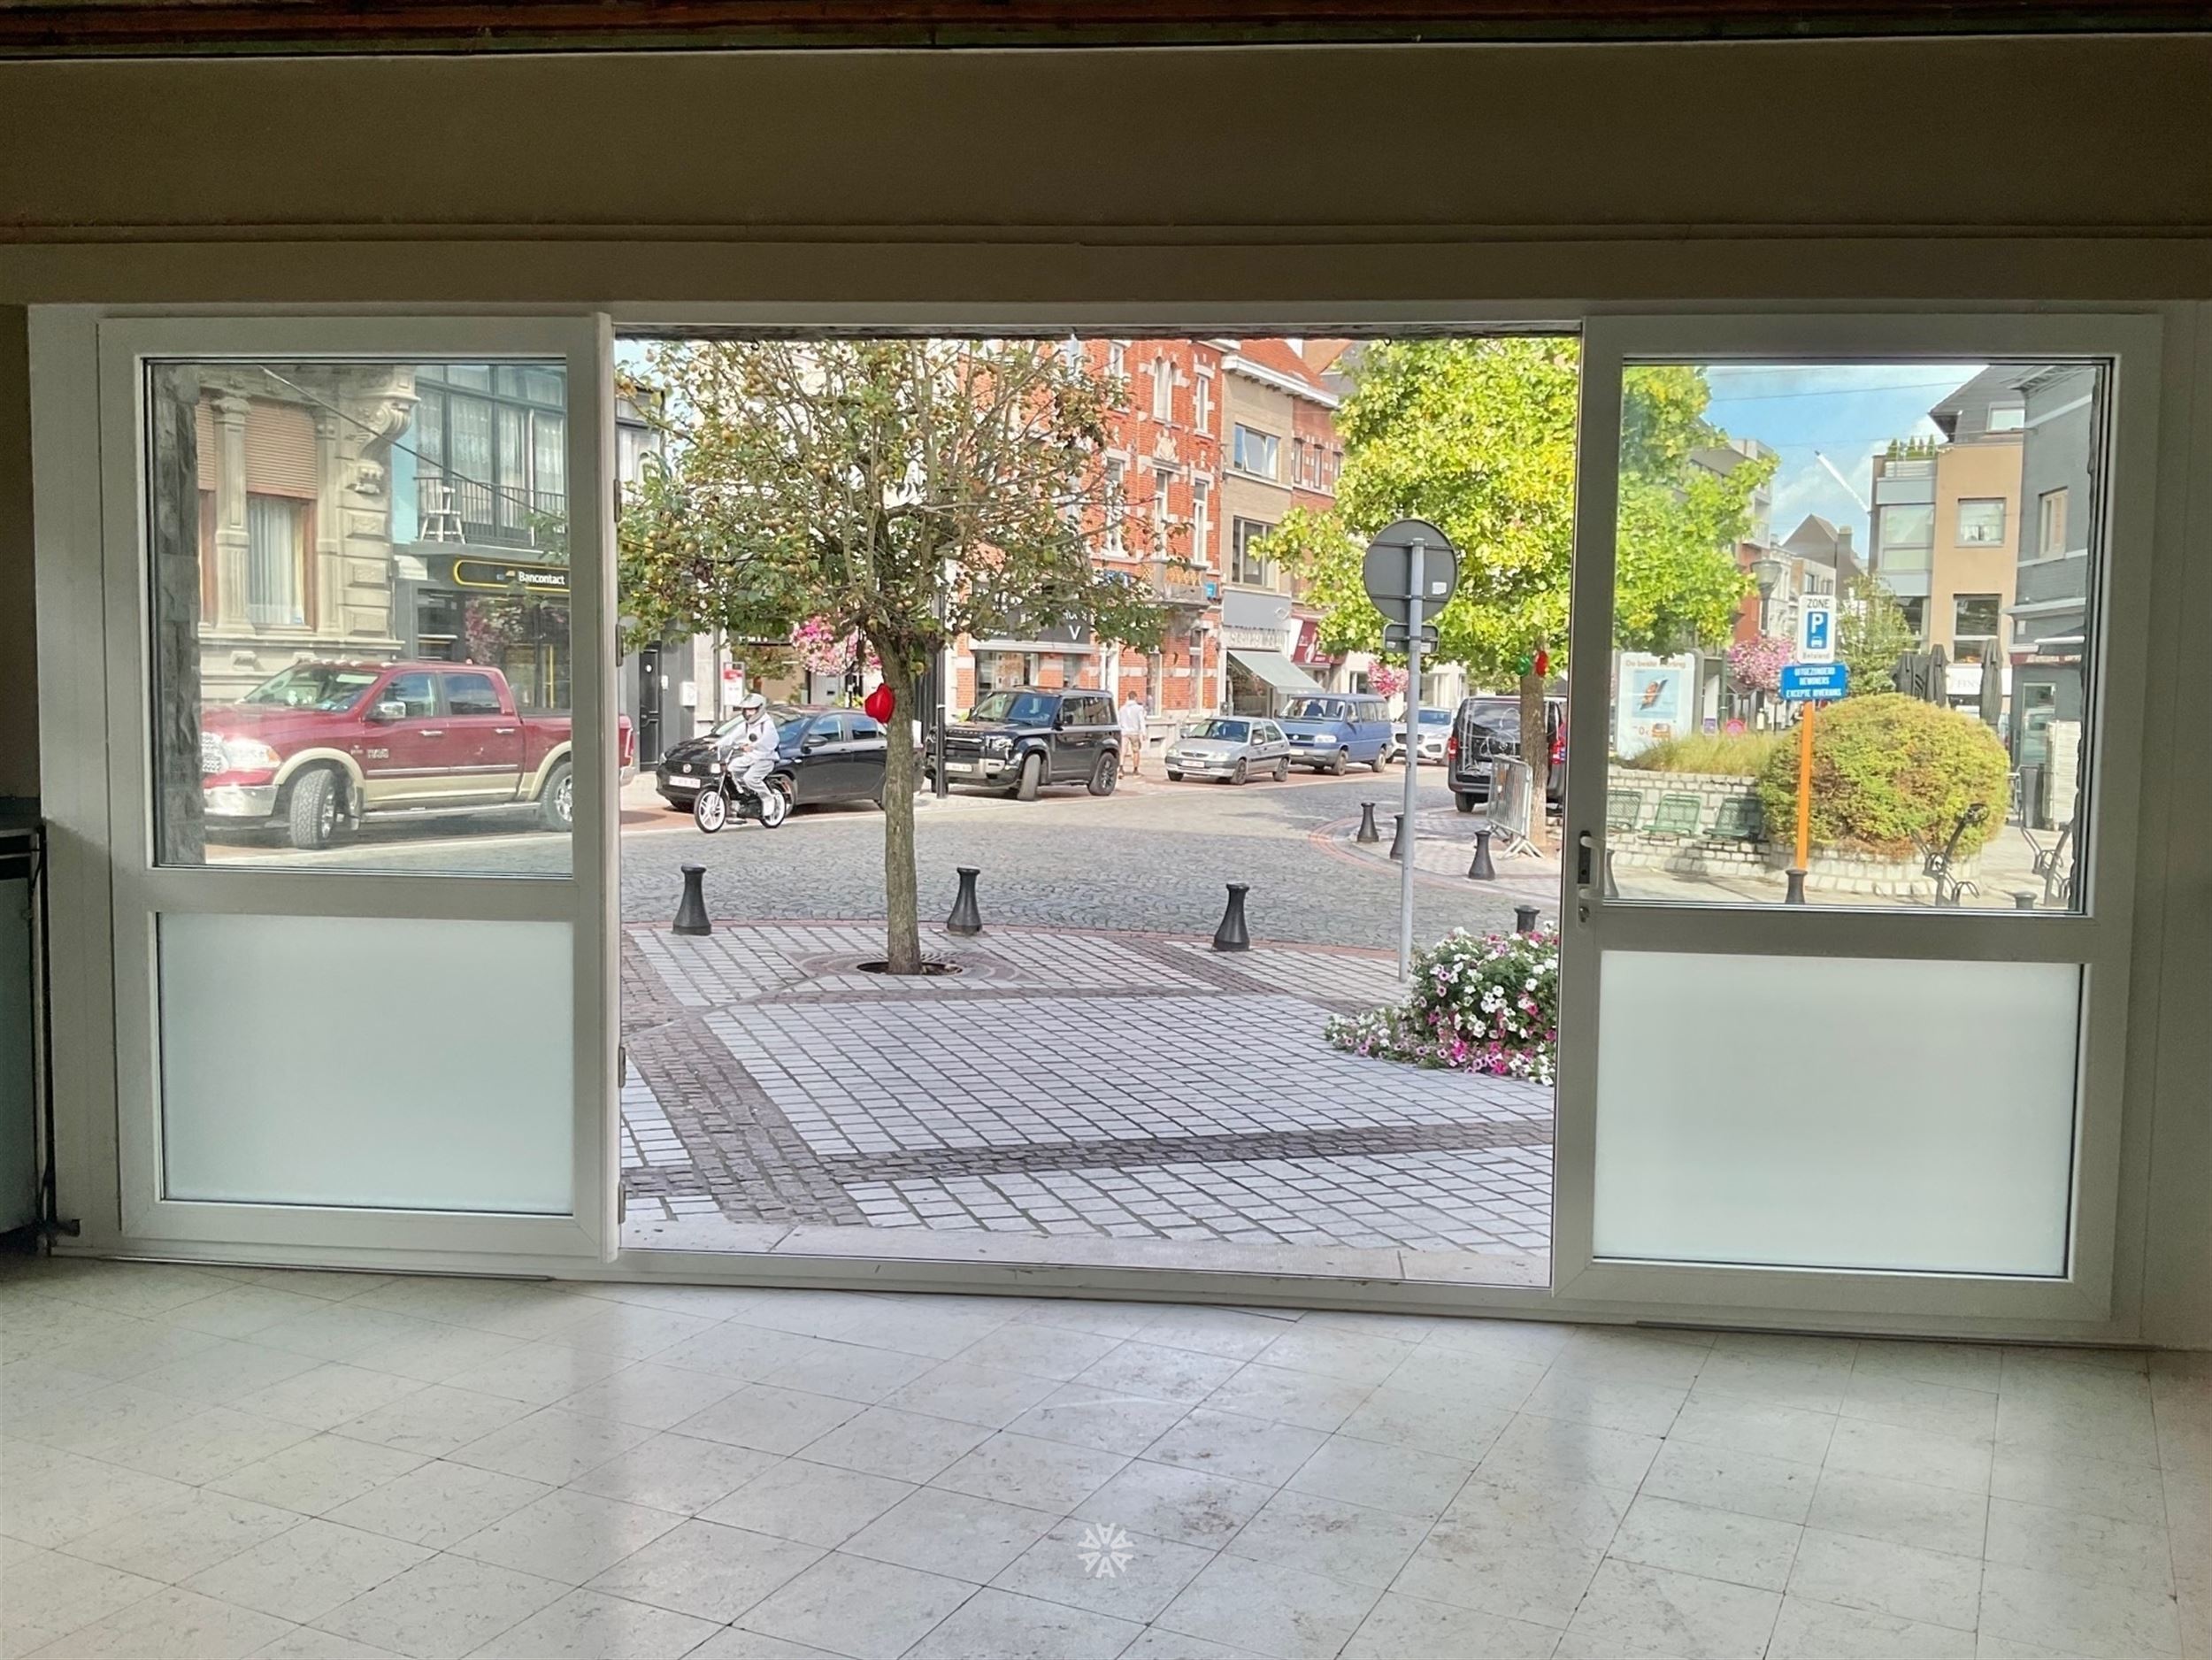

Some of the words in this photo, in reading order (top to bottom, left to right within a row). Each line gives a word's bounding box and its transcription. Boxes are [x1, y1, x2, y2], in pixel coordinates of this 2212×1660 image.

[518, 571, 565, 585] Bancontact
[1807, 598, 1830, 609] ZONE
[1811, 612, 1824, 634] P
